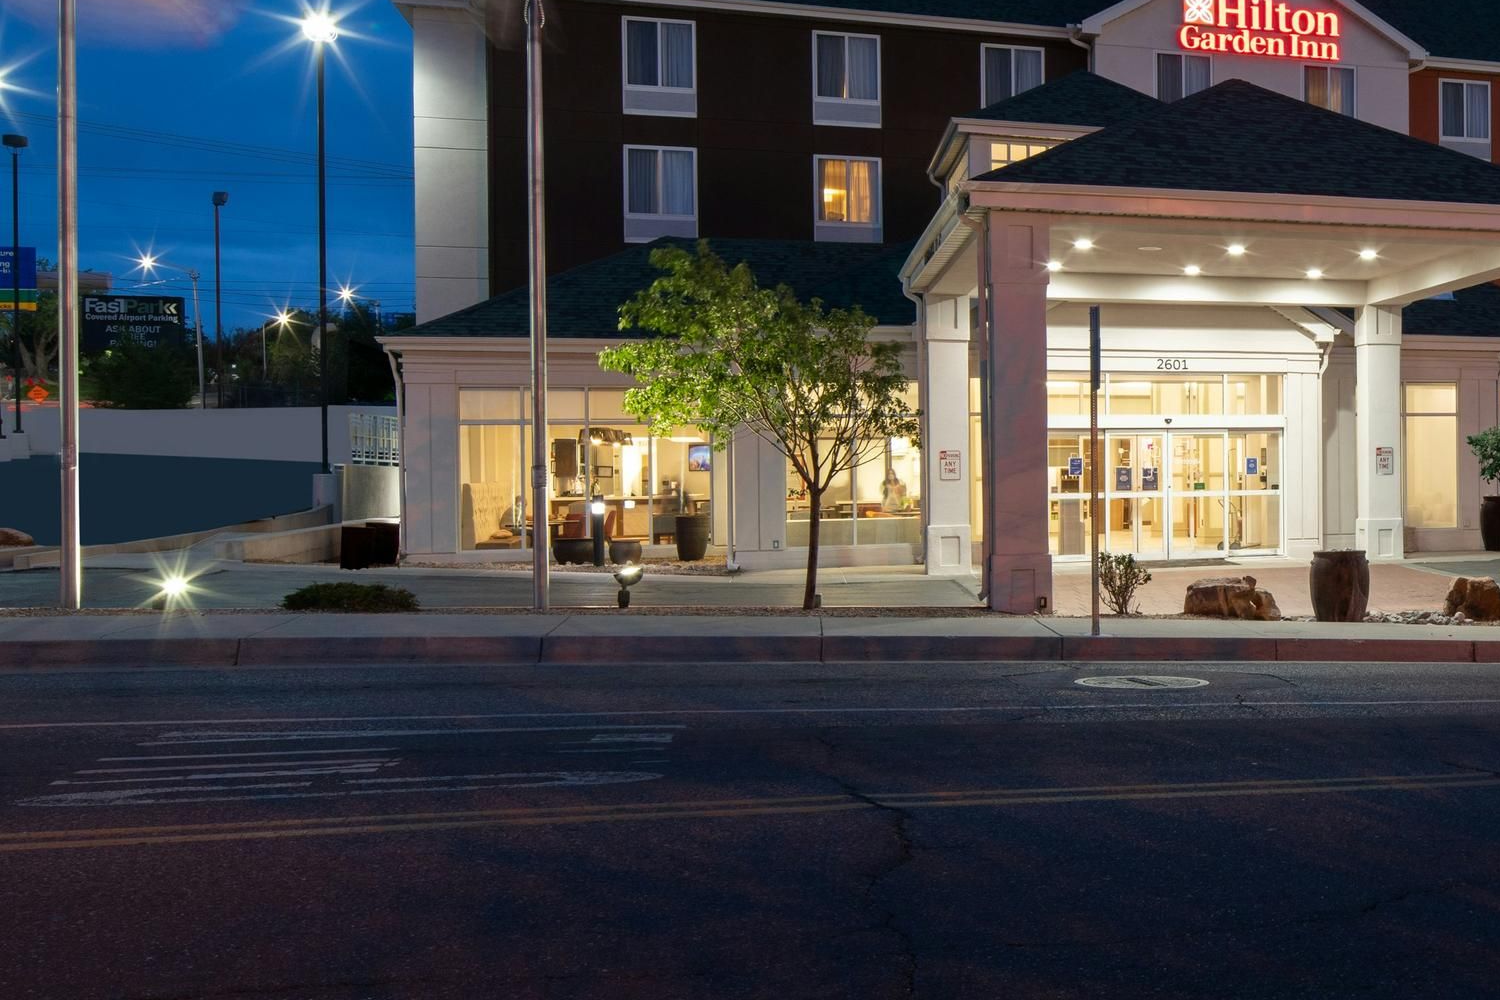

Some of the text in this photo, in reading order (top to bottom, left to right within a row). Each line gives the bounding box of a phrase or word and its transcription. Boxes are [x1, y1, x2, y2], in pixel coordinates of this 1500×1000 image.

[1180, 25, 1340, 61] Garden Inn
[85, 313, 179, 324] Covered Airport Parking
[128, 324, 161, 334] ABOUT
[1156, 358, 1189, 370] 2601
